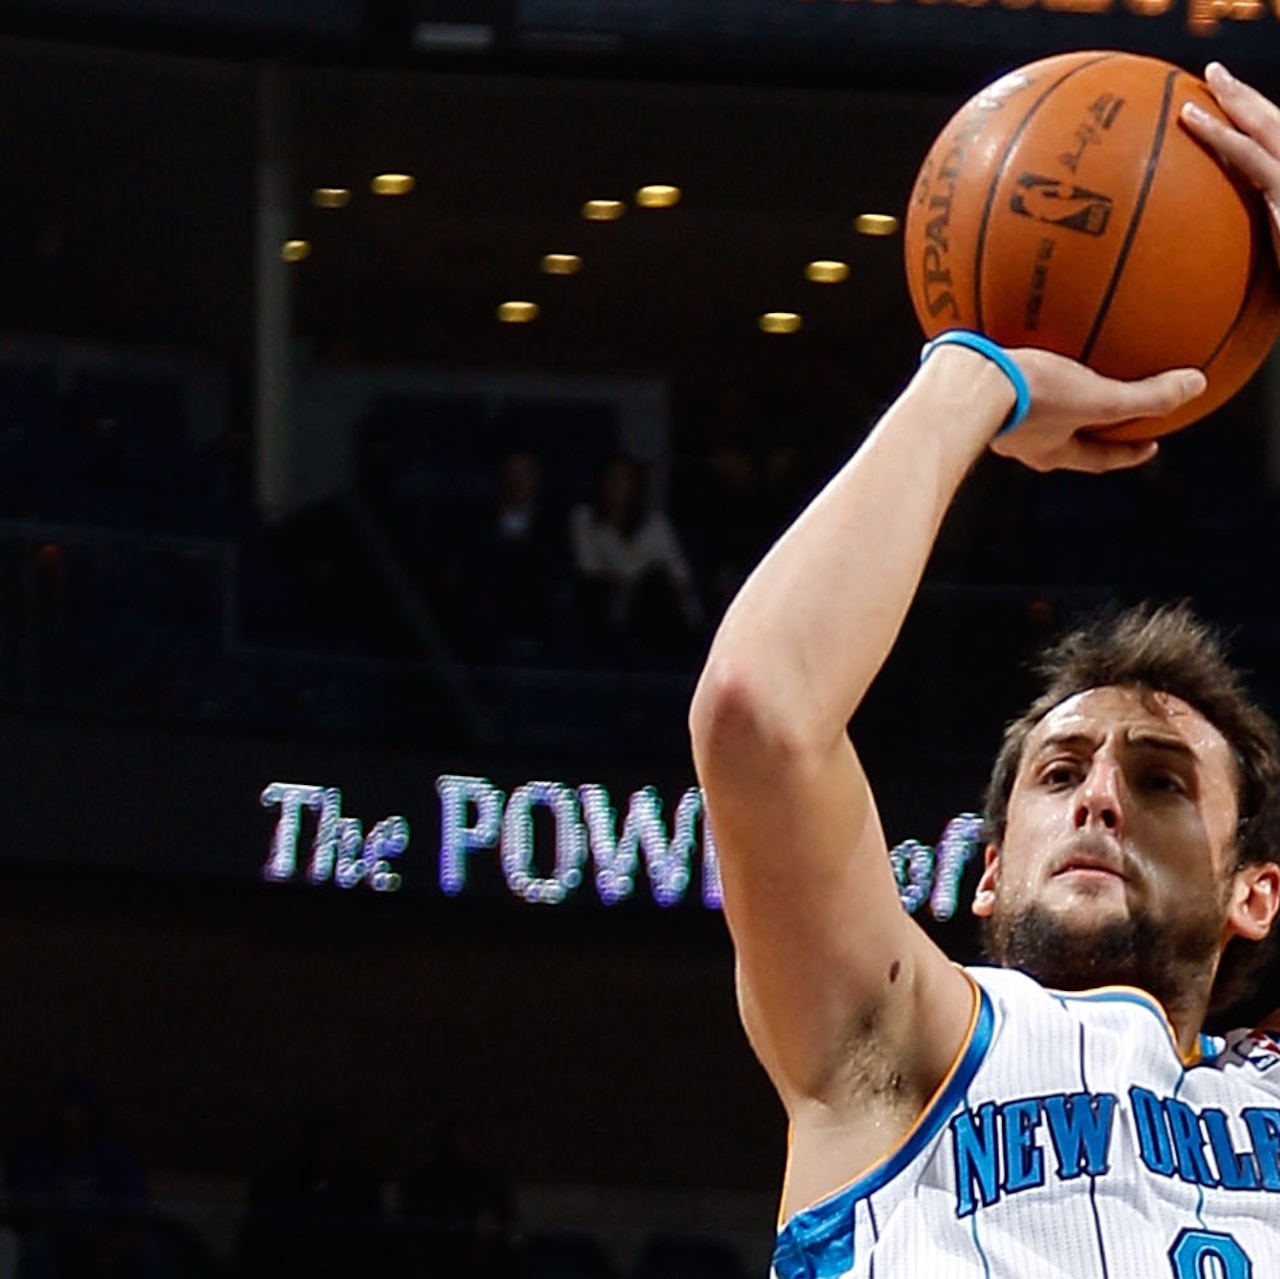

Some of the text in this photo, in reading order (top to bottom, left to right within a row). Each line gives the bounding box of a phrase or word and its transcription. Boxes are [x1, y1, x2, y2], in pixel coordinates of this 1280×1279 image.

[261, 782, 408, 892] The
[436, 774, 724, 908] POW
[949, 1091, 1118, 1219] NEW
